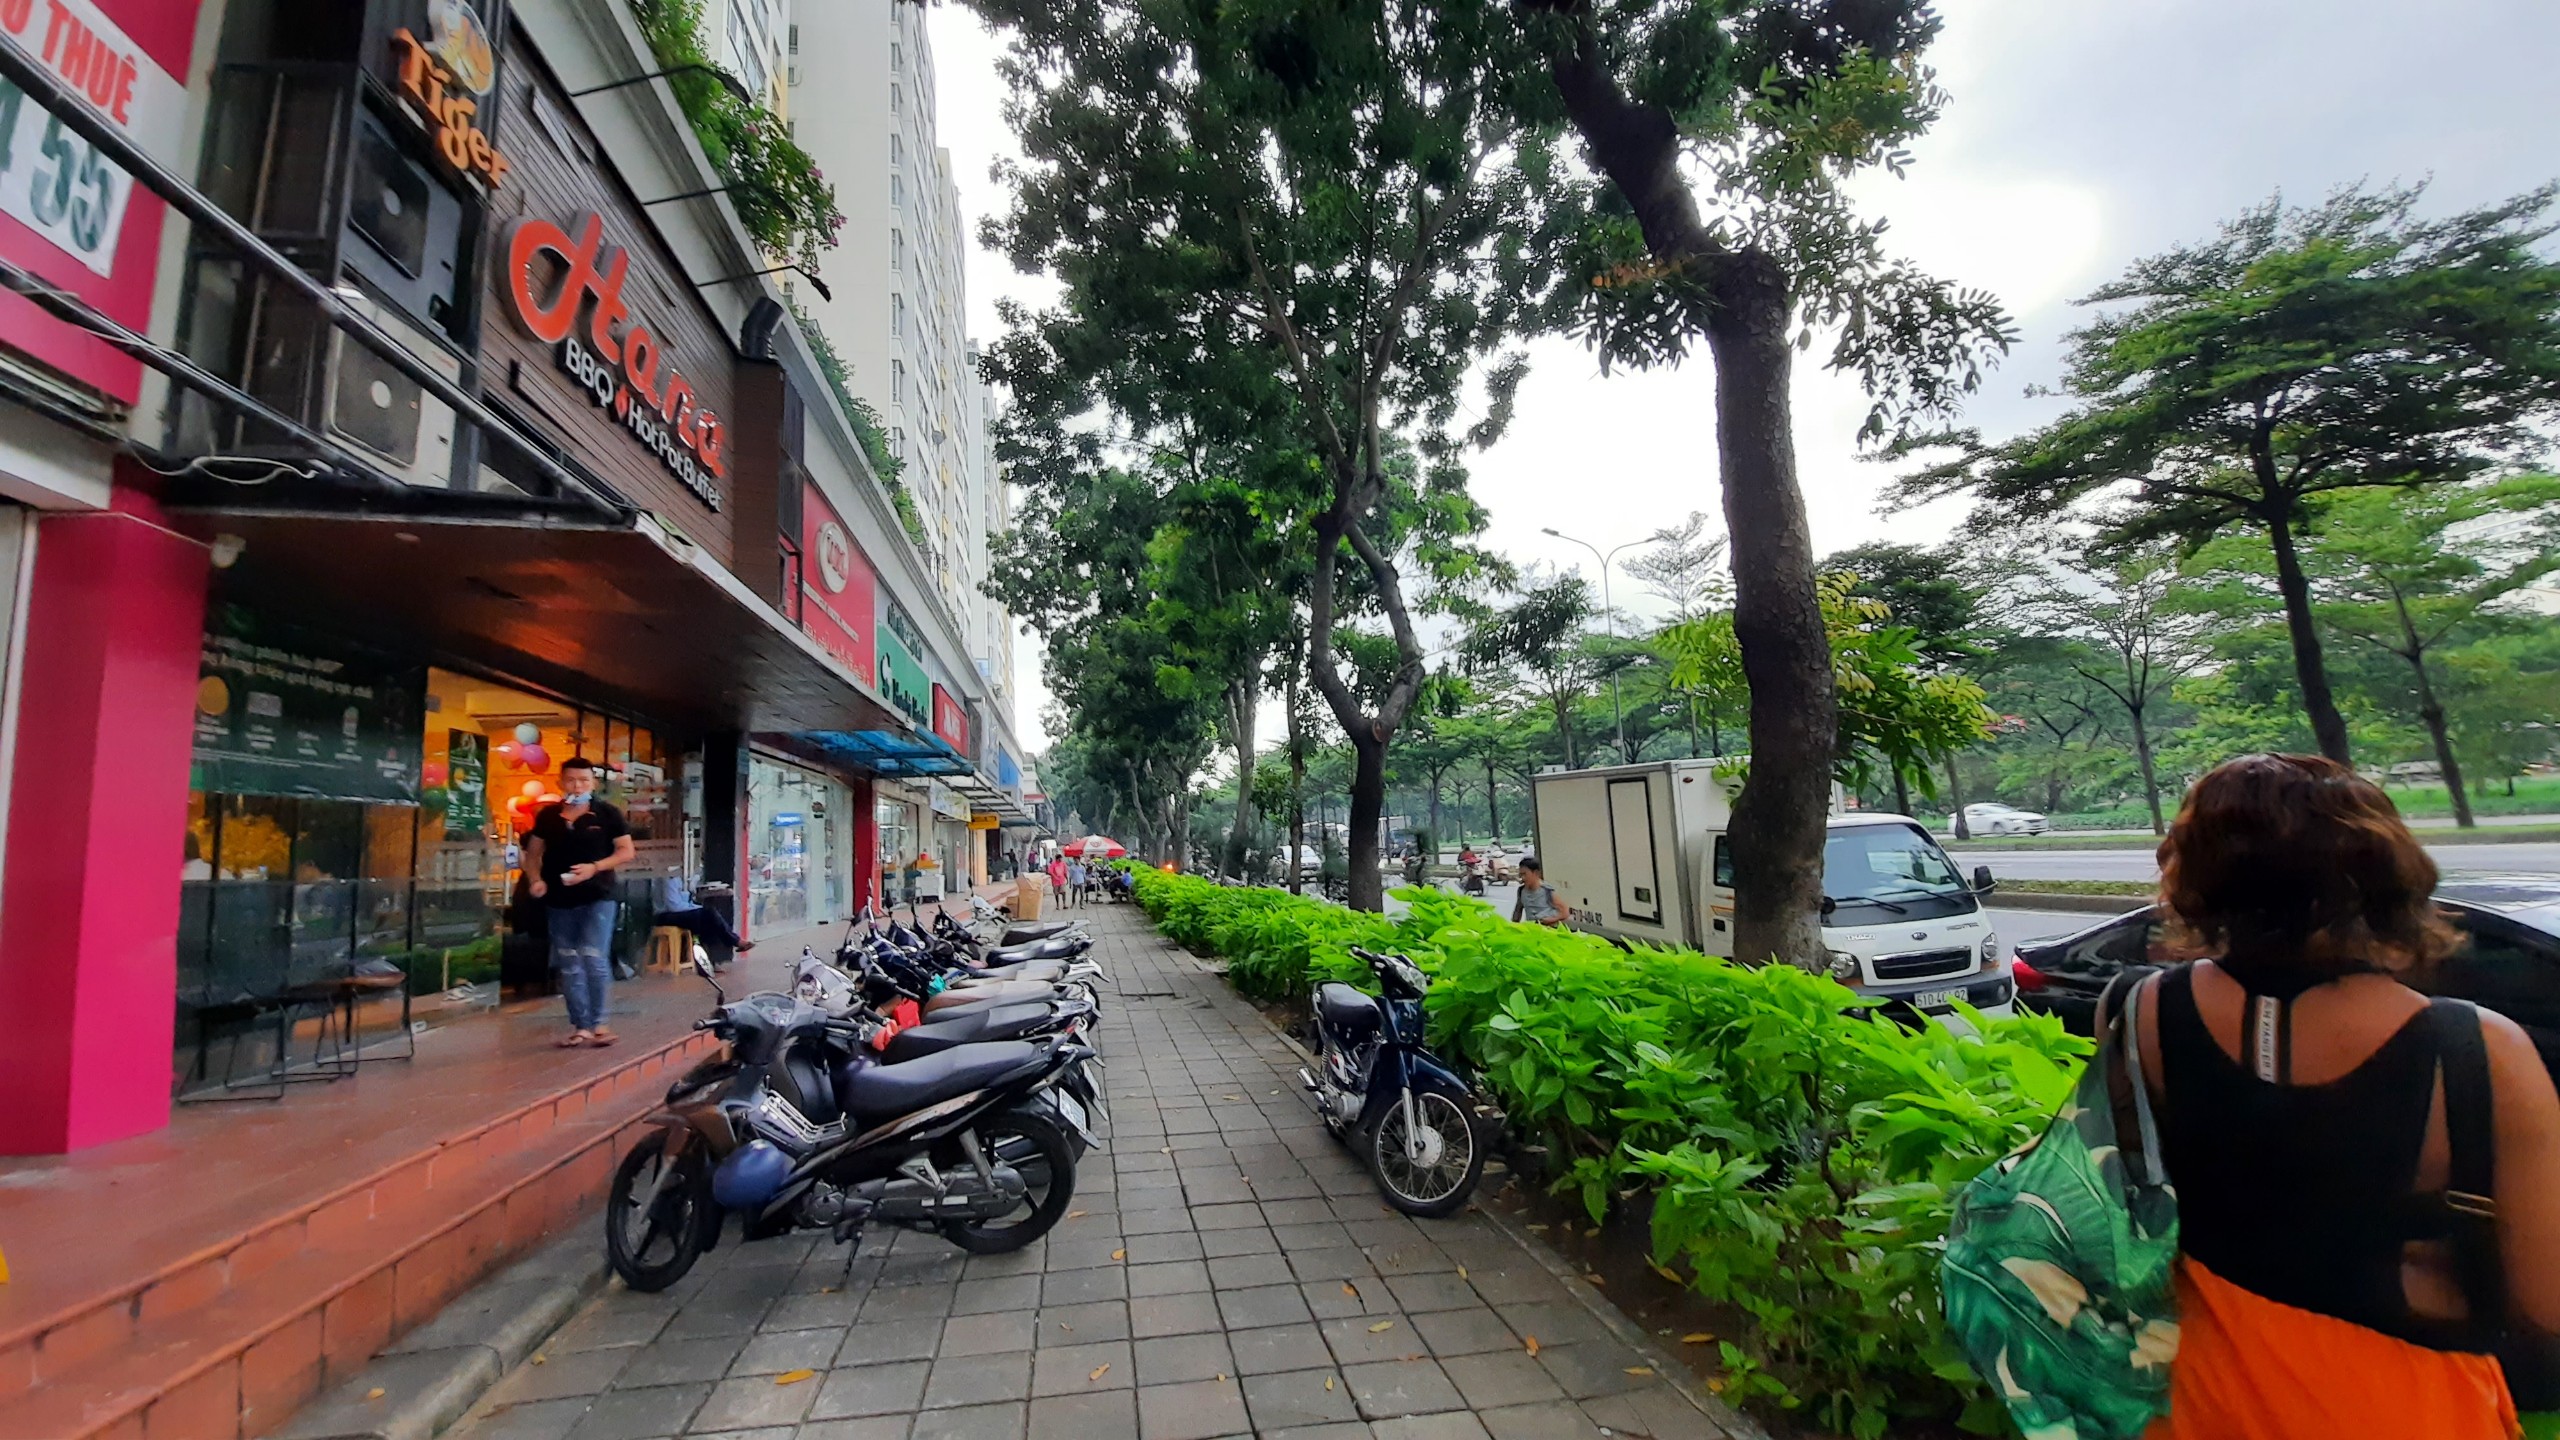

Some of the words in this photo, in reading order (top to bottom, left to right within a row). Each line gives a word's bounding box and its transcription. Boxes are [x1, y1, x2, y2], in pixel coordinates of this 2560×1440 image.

[41, 0, 138, 127] THUÊ
[386, 26, 510, 190] Tiger
[565, 337, 614, 408] BBQ
